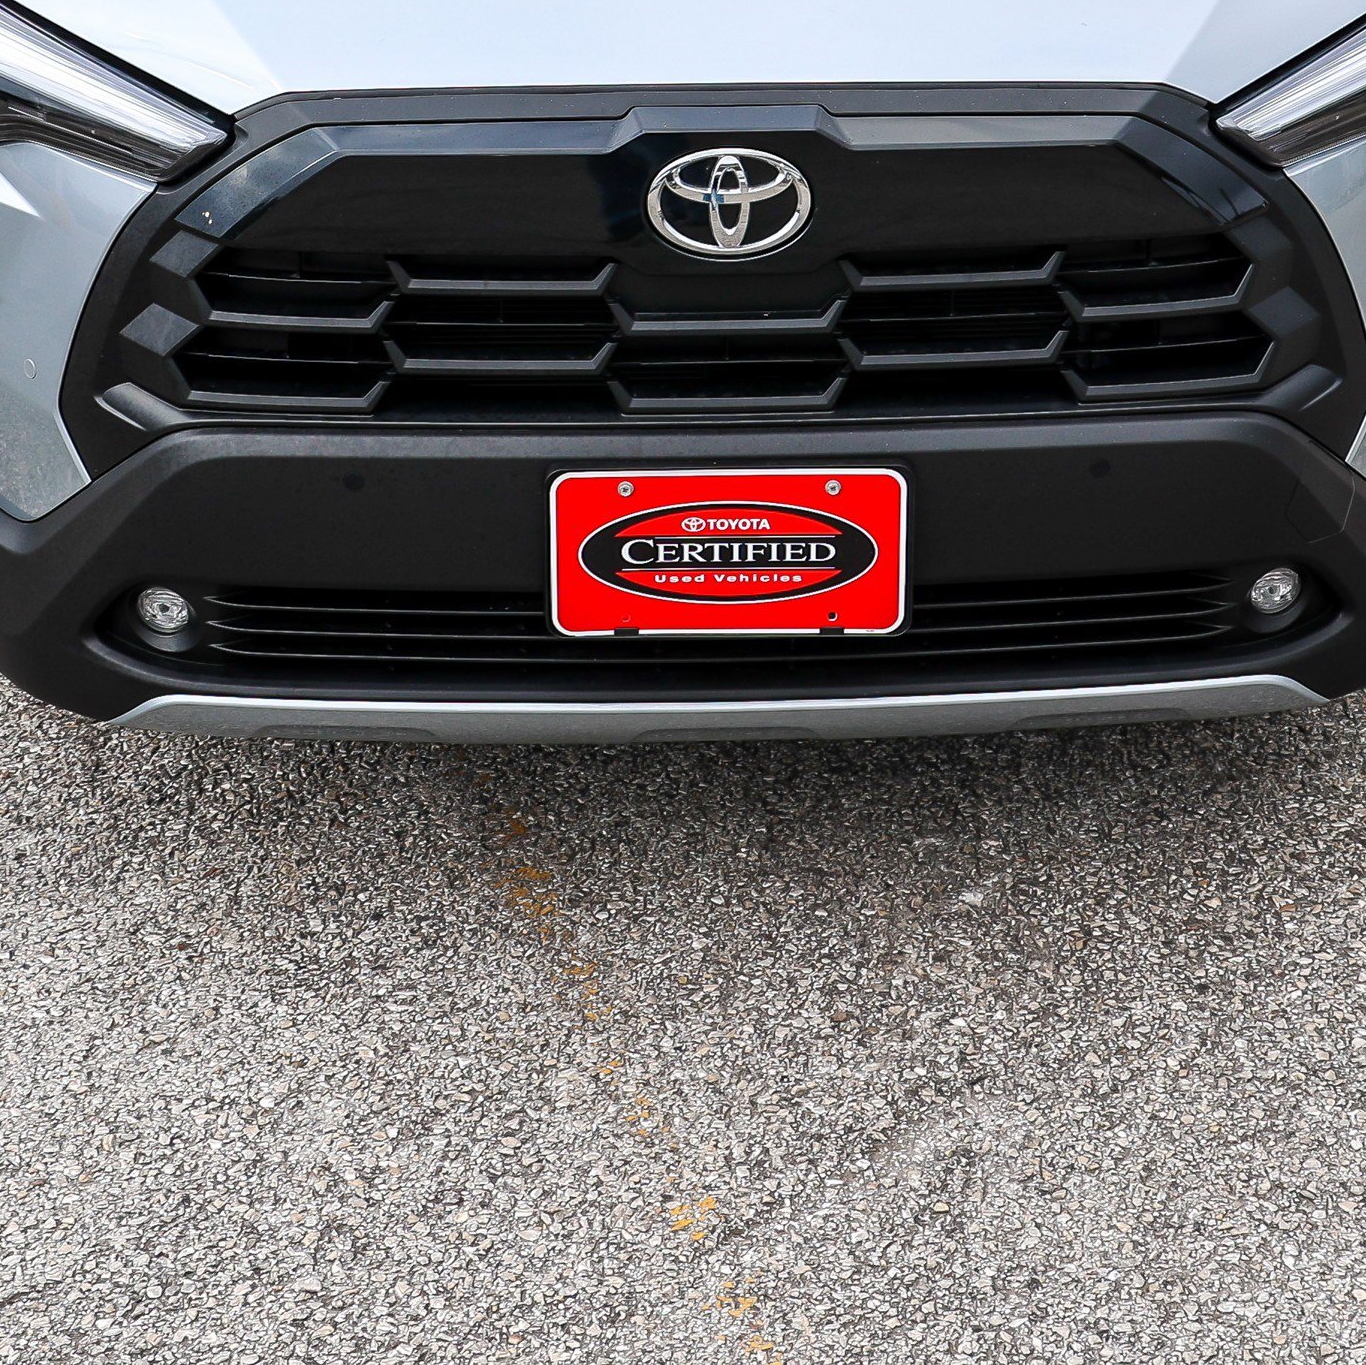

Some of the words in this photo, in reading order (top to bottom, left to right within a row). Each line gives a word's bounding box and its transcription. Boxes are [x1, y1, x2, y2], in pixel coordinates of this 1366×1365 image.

[707, 518, 771, 531] TOYOTA
[620, 538, 836, 564] CERTIFIED
[654, 573, 705, 583] Used
[713, 573, 803, 583] Vehicles
